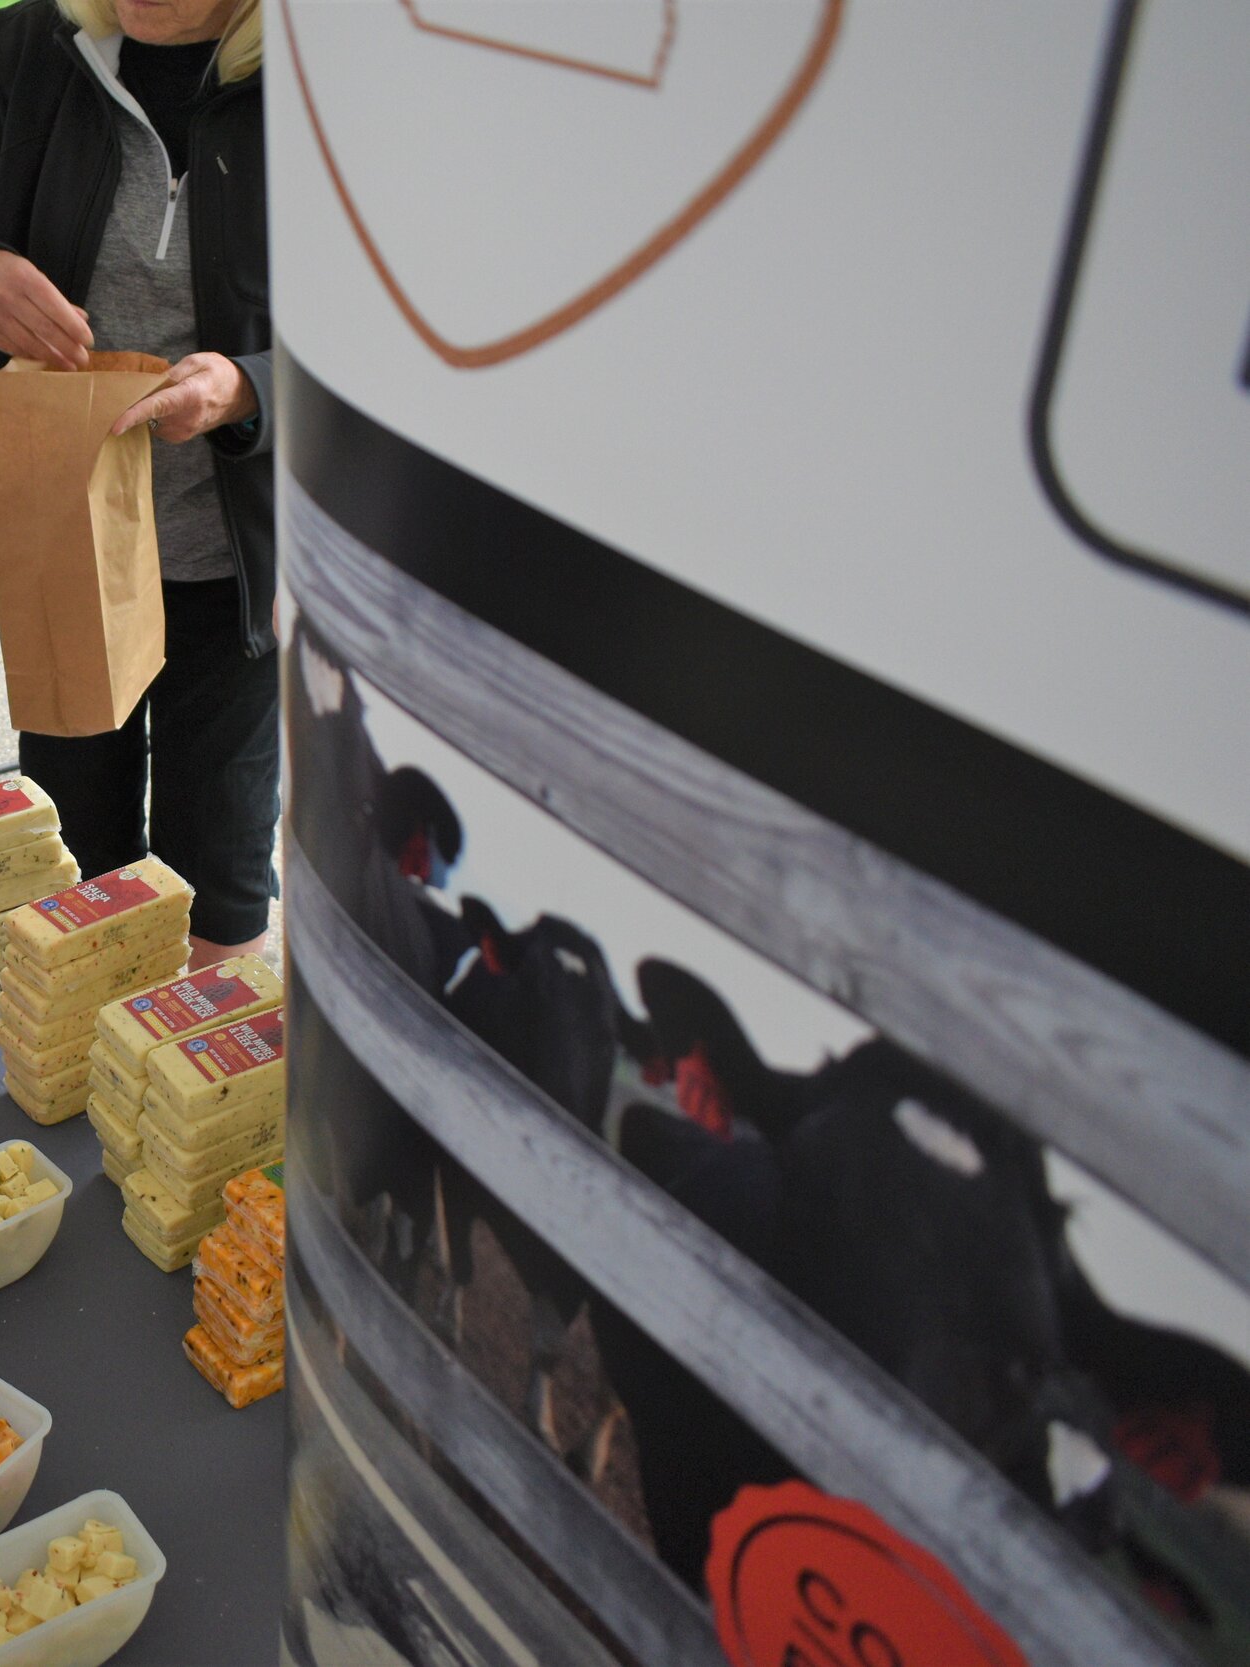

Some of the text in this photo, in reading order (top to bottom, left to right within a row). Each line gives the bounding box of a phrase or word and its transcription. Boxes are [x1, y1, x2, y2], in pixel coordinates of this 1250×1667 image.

[76, 888, 99, 903] JACK
[85, 883, 111, 903] SALSA
[171, 984, 181, 992] &
[176, 990, 195, 1006] LEEK
[189, 1003, 212, 1019] JACK
[180, 980, 199, 996] WILD
[195, 994, 219, 1015] MOREL
[234, 1032, 252, 1049] LEEK
[246, 1046, 271, 1063] JACK
[239, 1024, 257, 1038] WILD
[253, 1037, 277, 1059] MOREL
[795, 1567, 906, 1667] CO
